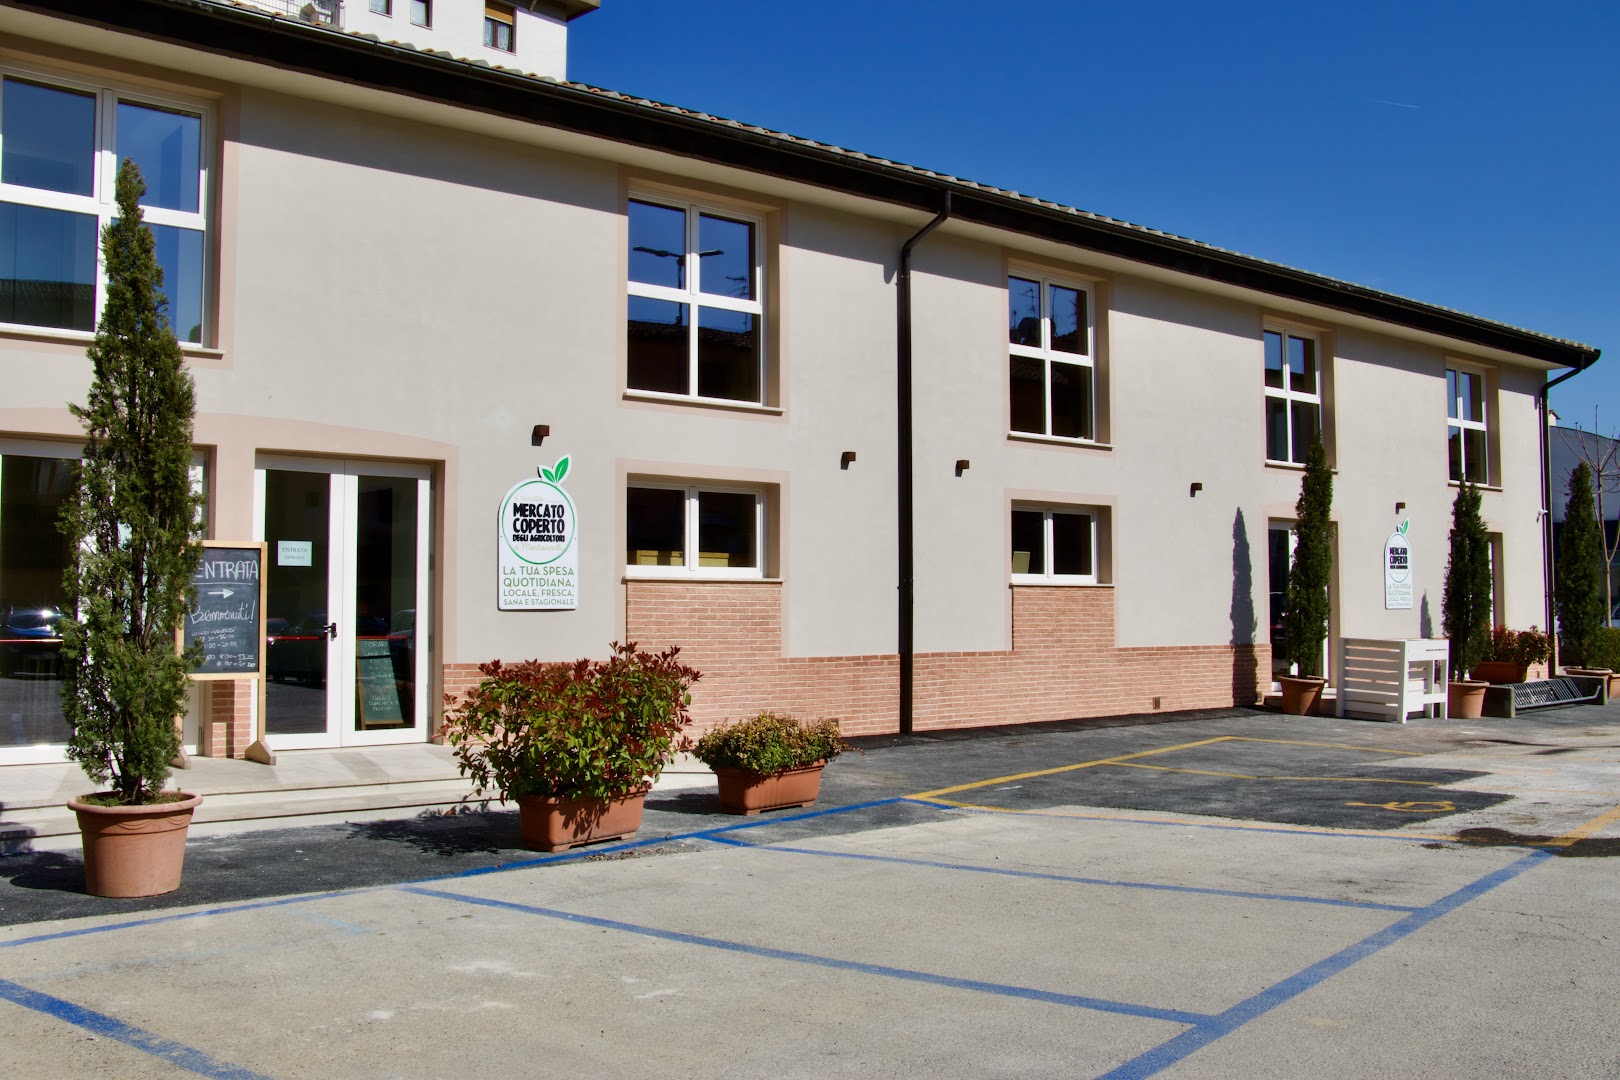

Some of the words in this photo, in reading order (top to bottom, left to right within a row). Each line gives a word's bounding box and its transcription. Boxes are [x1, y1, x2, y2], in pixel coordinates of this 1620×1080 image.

[513, 502, 564, 518] MERCATO
[513, 518, 565, 533] COPERTO
[503, 566, 516, 576] LA
[520, 566, 540, 576] TUA
[543, 566, 574, 576] SPESA
[504, 578, 574, 588] QUOTIDIANA,
[504, 588, 540, 597] LOCALE,
[542, 589, 574, 597] FRESCA,
